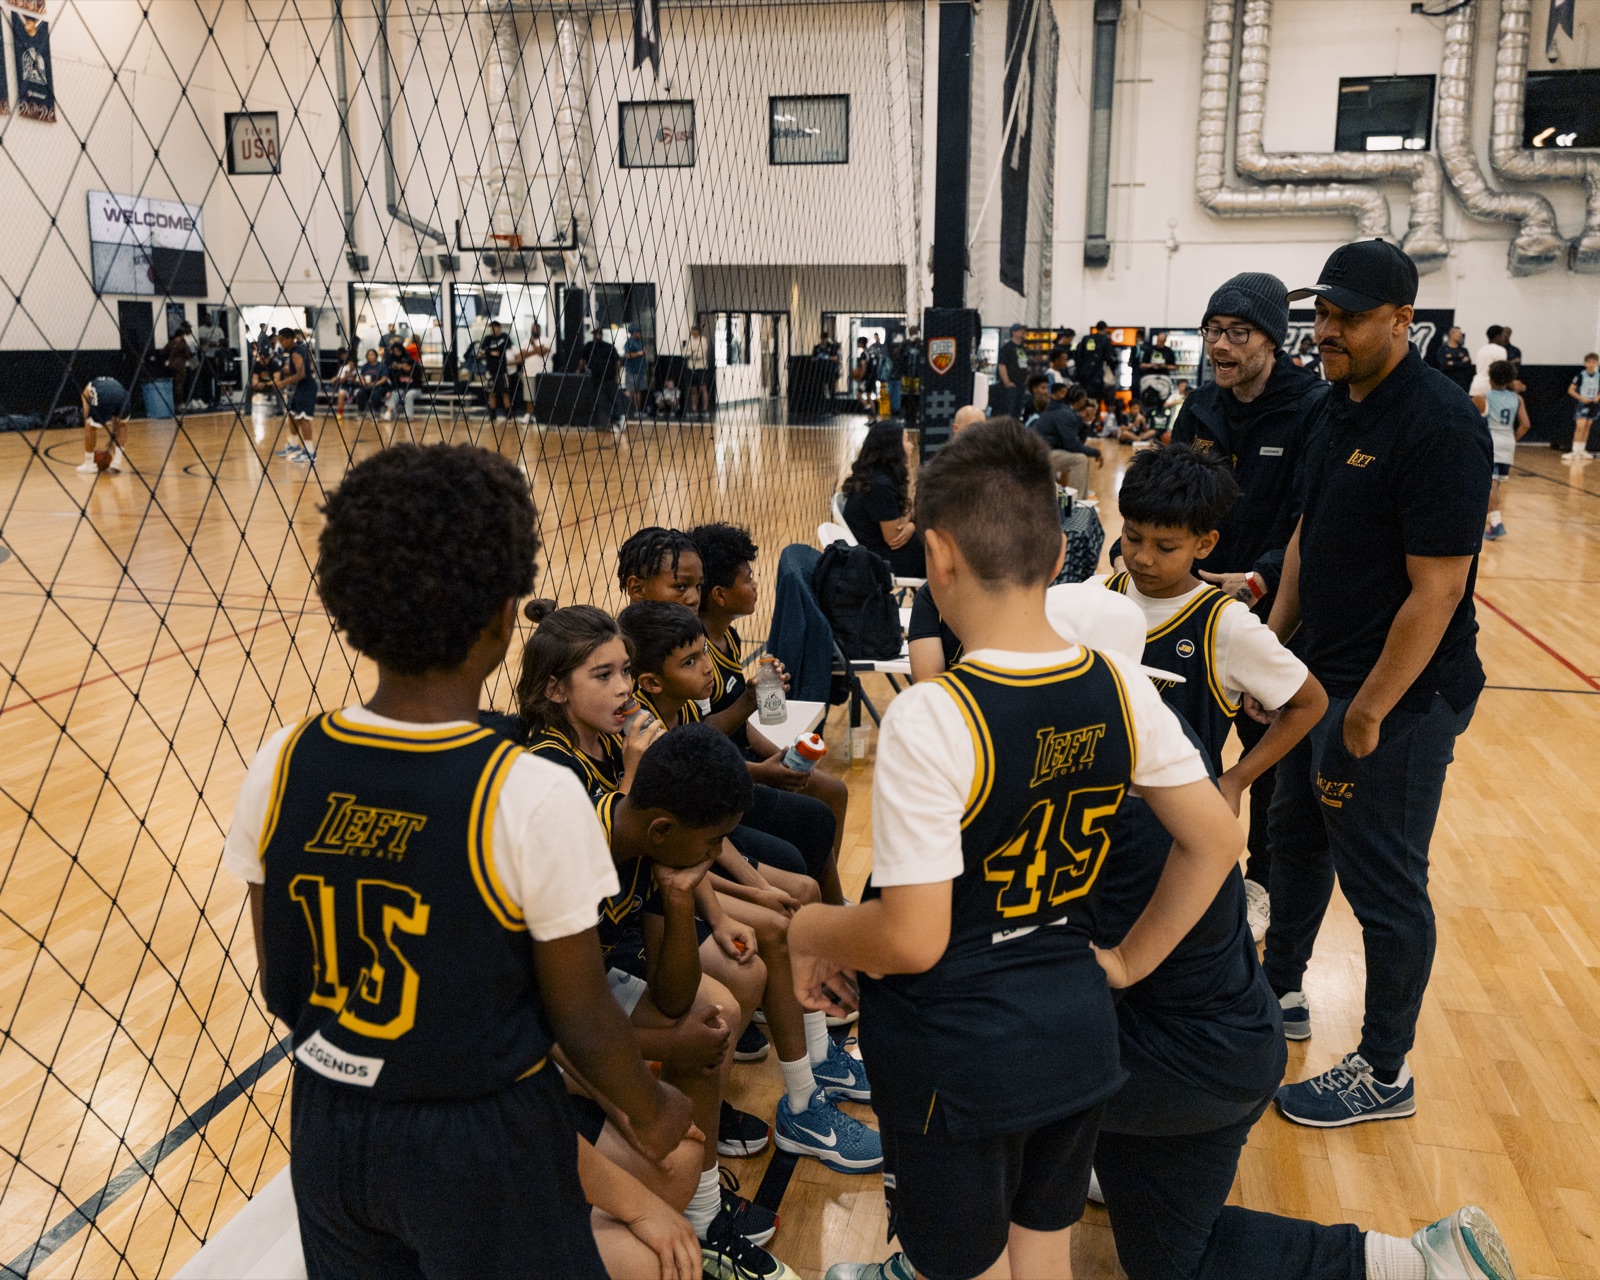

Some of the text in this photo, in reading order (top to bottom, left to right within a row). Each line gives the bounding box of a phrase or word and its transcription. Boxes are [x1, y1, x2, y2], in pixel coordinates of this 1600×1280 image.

[242, 139, 277, 160] USA
[103, 207, 194, 231] WELCOME
[1500, 408, 1511, 425] 9
[1346, 448, 1376, 465] LEFT
[763, 699, 782, 708] ZERO
[1029, 722, 1106, 788] LEFT
[303, 791, 428, 855] LEFT
[983, 783, 1125, 918] 45
[289, 874, 430, 1041] 15
[304, 1041, 369, 1078] LEGENDS
[1338, 1085, 1376, 1115] N
